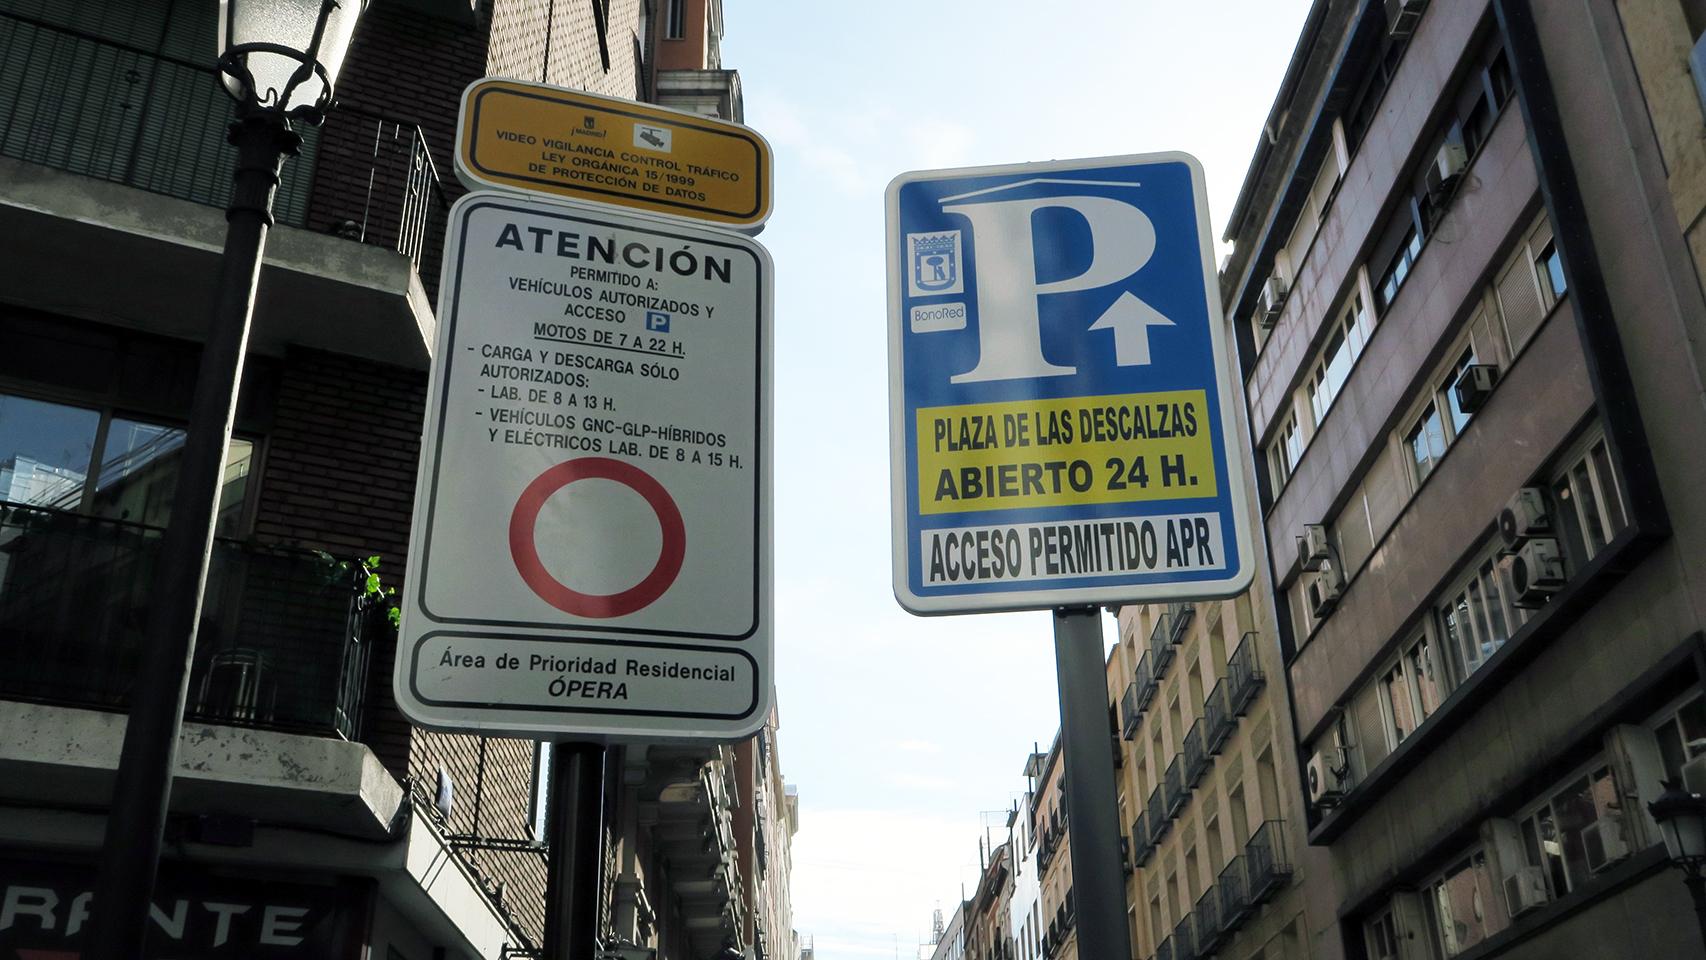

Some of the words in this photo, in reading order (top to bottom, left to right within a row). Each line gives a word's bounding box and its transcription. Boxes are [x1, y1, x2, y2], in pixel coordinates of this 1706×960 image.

[497, 130, 536, 145] VIDEO
[543, 137, 615, 159] VIGILANCIA
[621, 151, 681, 171] CONTROL
[687, 163, 739, 182] TRÁFICO
[542, 151, 568, 162] LEY
[572, 155, 639, 177] ORGÁNICA
[645, 169, 695, 187] 15/1999
[529, 162, 548, 174] DE
[553, 167, 636, 190] PROTECCIÓN
[643, 181, 660, 193] DE
[666, 186, 706, 202] DATOS
[496, 223, 731, 284] ATENCIÓN
[509, 275, 592, 300] VEHÍCULOS
[599, 290, 699, 317] AUTORIZADOS
[706, 306, 714, 319] Y
[570, 266, 641, 288] PERMITIDO
[646, 278, 658, 291] A:
[942, 196, 1156, 384] P
[564, 304, 625, 323] ACCESO
[915, 306, 964, 321] BonoRed
[534, 322, 586, 341] MOTOS
[594, 330, 612, 344] DE
[619, 334, 627, 346] 7
[633, 336, 643, 348] A
[649, 338, 666, 351] 22
[673, 342, 686, 355] H.
[480, 364, 589, 388] AUTORIZADOS:
[482, 344, 532, 363] CARGA
[539, 351, 548, 363] Y
[555, 354, 634, 375] DESCARGA
[640, 360, 679, 381] SÓLO
[491, 386, 521, 401] LAB.
[528, 390, 546, 403] DE
[553, 392, 562, 405] 8
[568, 394, 577, 407] A
[584, 396, 597, 409] 13
[604, 398, 616, 412] H.
[490, 407, 575, 429] VEHÍCULOS
[583, 420, 726, 447] GNC-GLP-HÍBRIDOS
[934, 415, 998, 452] PLAZA
[1004, 412, 1030, 448] DE
[1035, 409, 1073, 446] LAS
[1079, 402, 1197, 443] DESCALZAS
[488, 429, 498, 442] Y
[505, 428, 602, 452] ELÉCTRICOS
[609, 440, 642, 457] LAB.
[649, 445, 669, 460] DE
[676, 448, 684, 461] 8
[691, 451, 701, 464] A
[708, 452, 722, 466] 15
[729, 455, 743, 469] H.
[934, 459, 1093, 502] ABIERTO
[1105, 456, 1148, 490] 24
[1161, 454, 1198, 487] H.
[930, 528, 1022, 582] ACCESO
[1031, 520, 1157, 576] PERMITIDO
[1166, 517, 1214, 568] APR
[440, 646, 485, 669] Área
[495, 653, 520, 670] de
[529, 655, 616, 675] Prioridad
[626, 659, 735, 682] Residencial
[548, 676, 629, 700] ÓPERA
